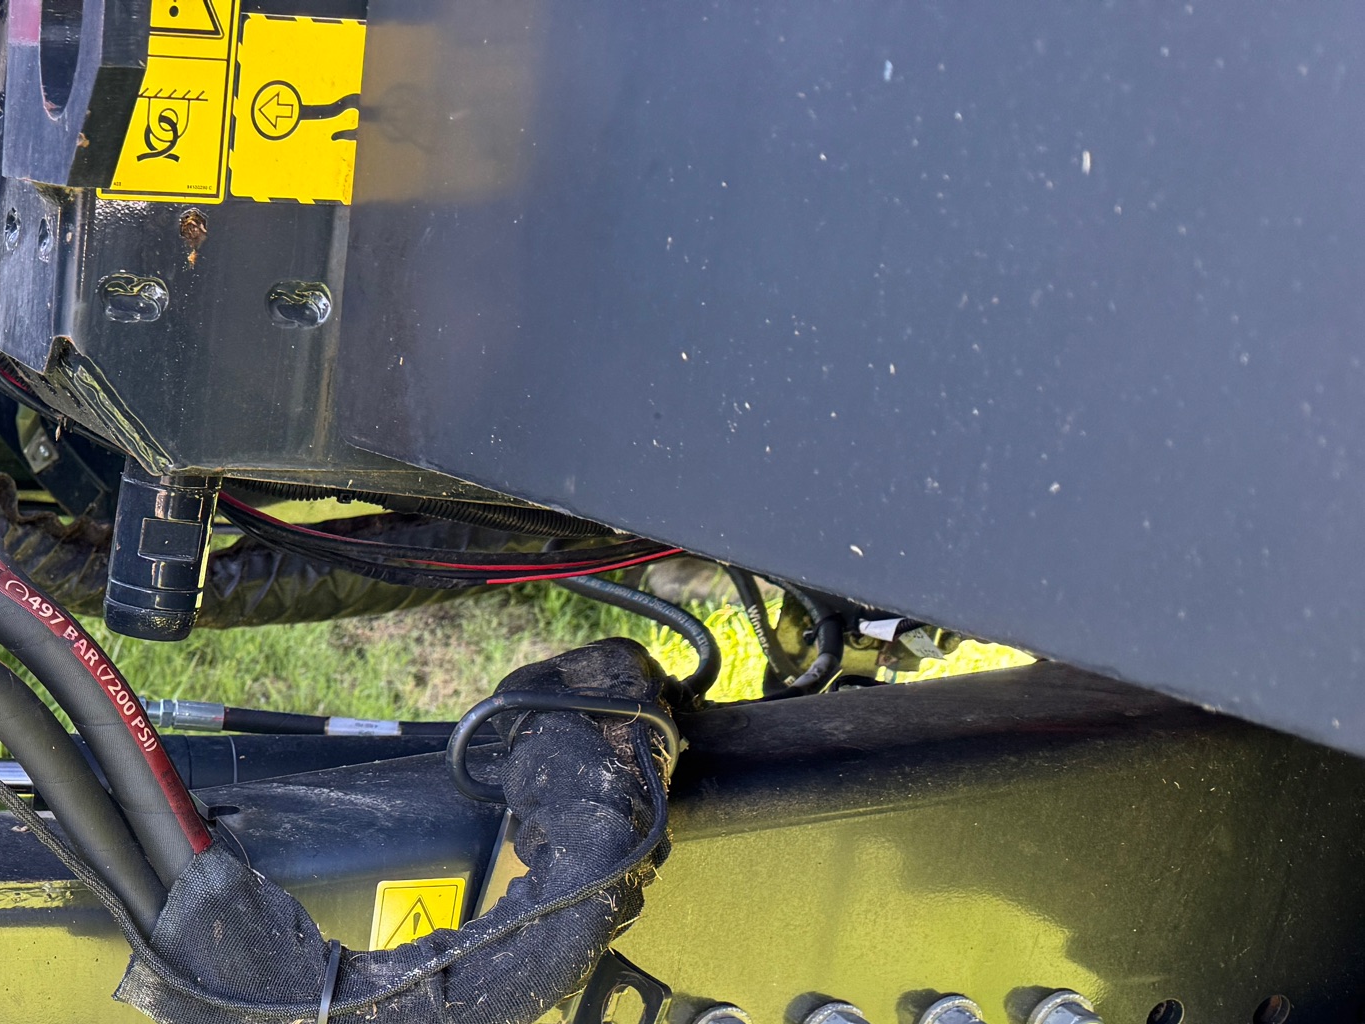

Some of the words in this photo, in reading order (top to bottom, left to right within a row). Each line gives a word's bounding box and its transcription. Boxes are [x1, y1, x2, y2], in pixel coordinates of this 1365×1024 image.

[27, 596, 65, 626] 497
[63, 625, 99, 667] BAR
[97, 664, 136, 716] (7200
[131, 716, 158, 753] PSI)
[747, 604, 770, 650] Winner
